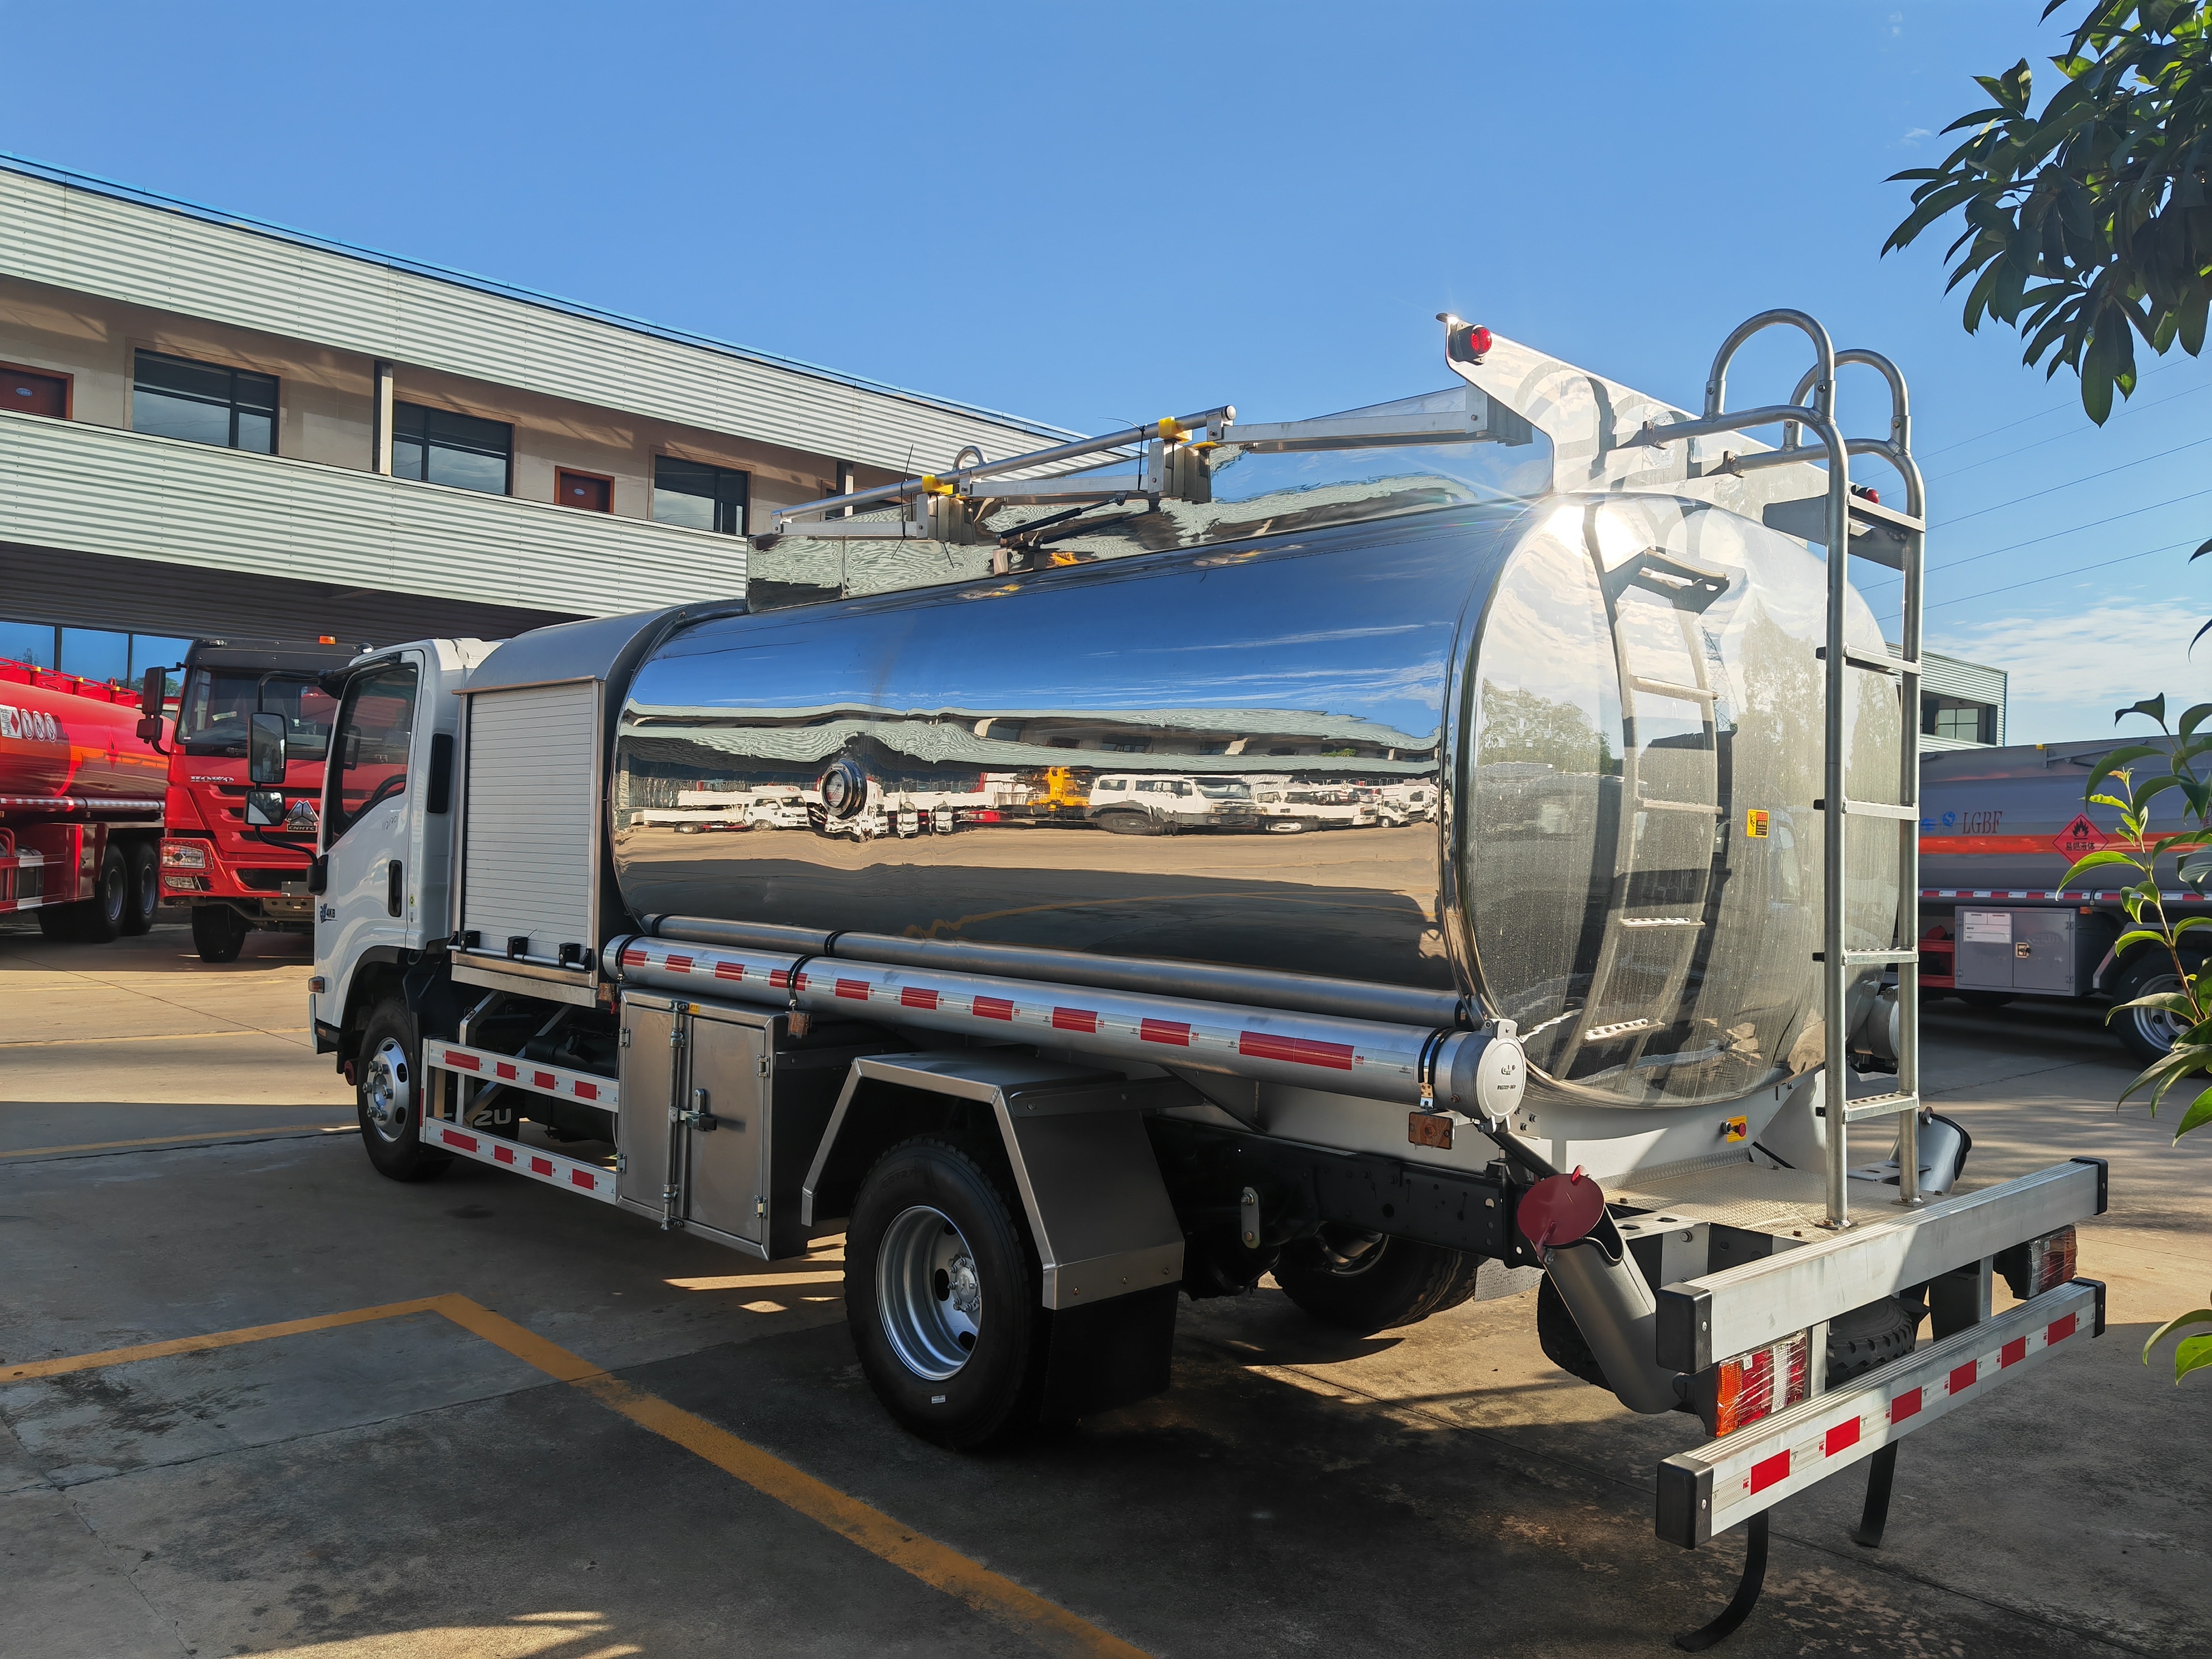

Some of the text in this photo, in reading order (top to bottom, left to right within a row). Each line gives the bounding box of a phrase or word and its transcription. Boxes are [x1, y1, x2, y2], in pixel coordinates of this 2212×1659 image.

[1963, 811, 2003, 834] LGBF
[2066, 841, 2095, 851] 易燃液体
